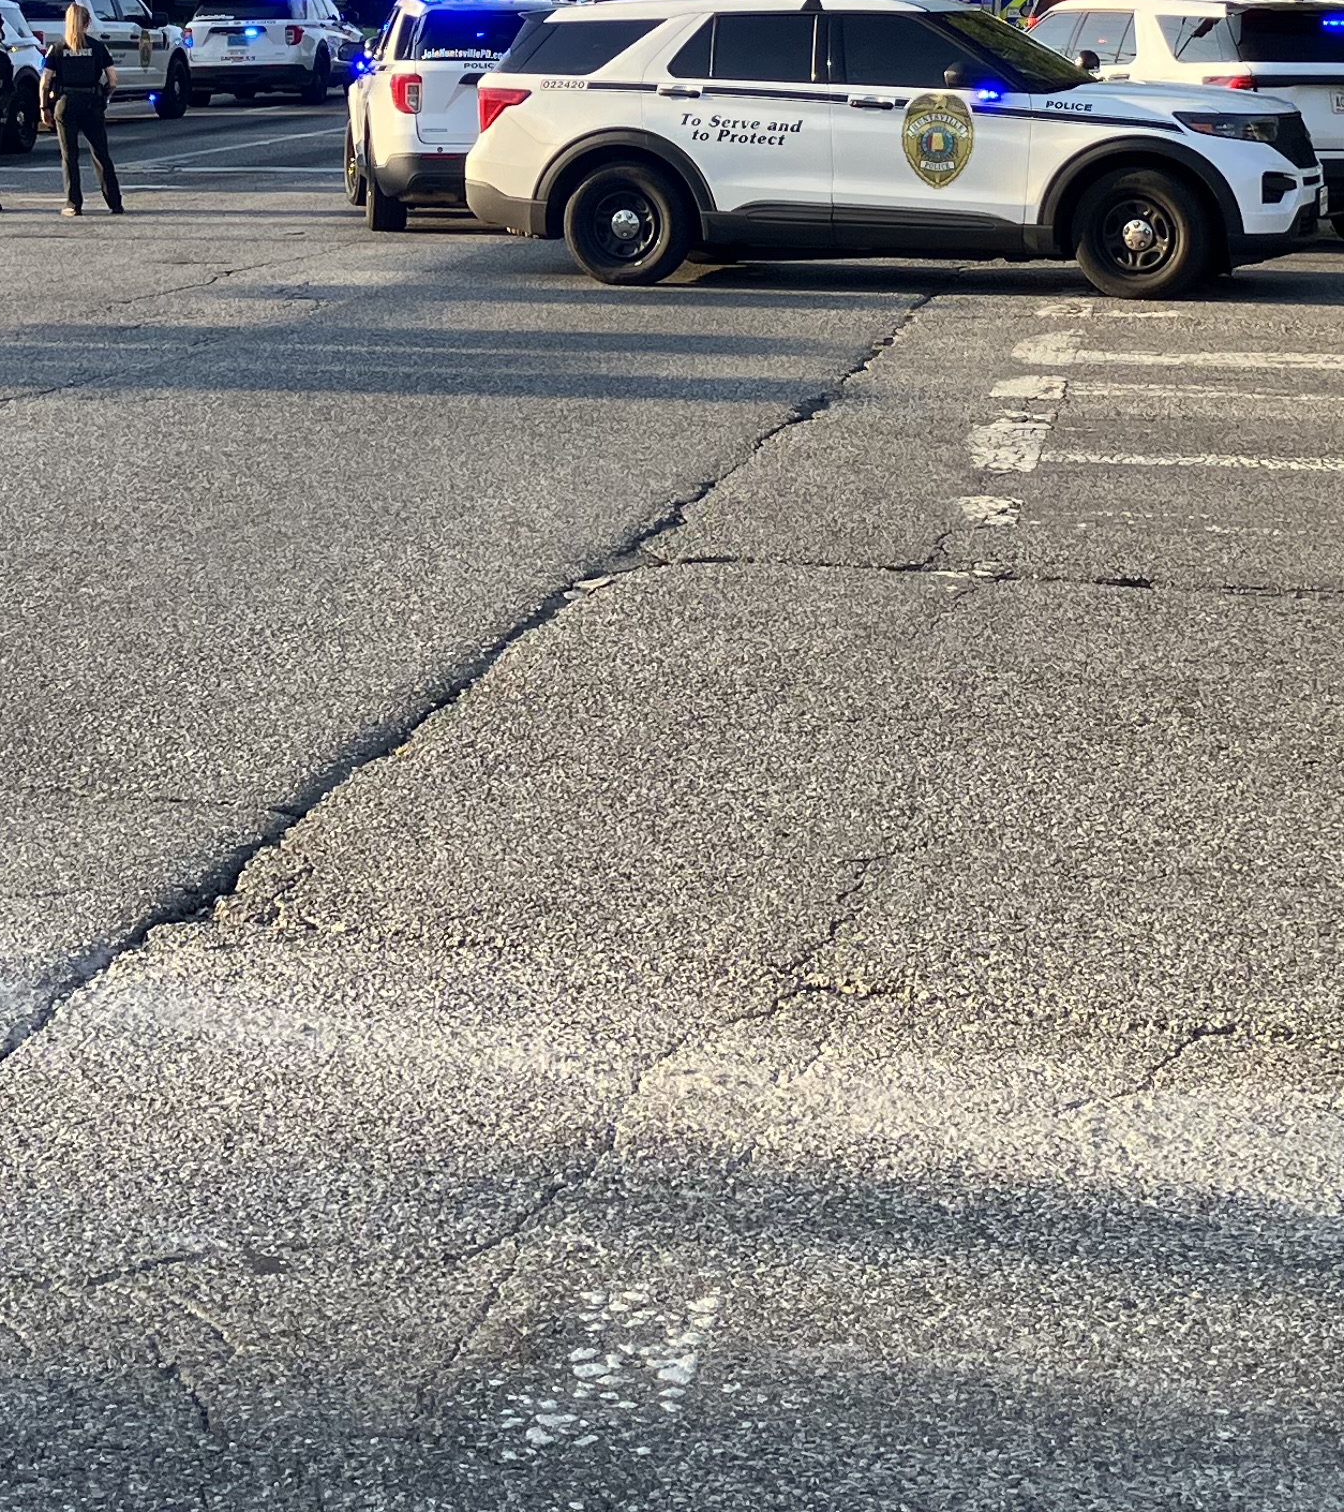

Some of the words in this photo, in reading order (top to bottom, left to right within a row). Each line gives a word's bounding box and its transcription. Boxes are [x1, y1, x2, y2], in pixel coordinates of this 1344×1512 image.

[463, 62, 495, 70] POLIC
[543, 81, 585, 89] 022420
[1046, 100, 1093, 112] POLICE
[681, 113, 701, 126] To
[708, 114, 760, 130] Serve
[767, 119, 803, 133] and
[691, 129, 710, 141] to
[716, 129, 785, 146] Protect
